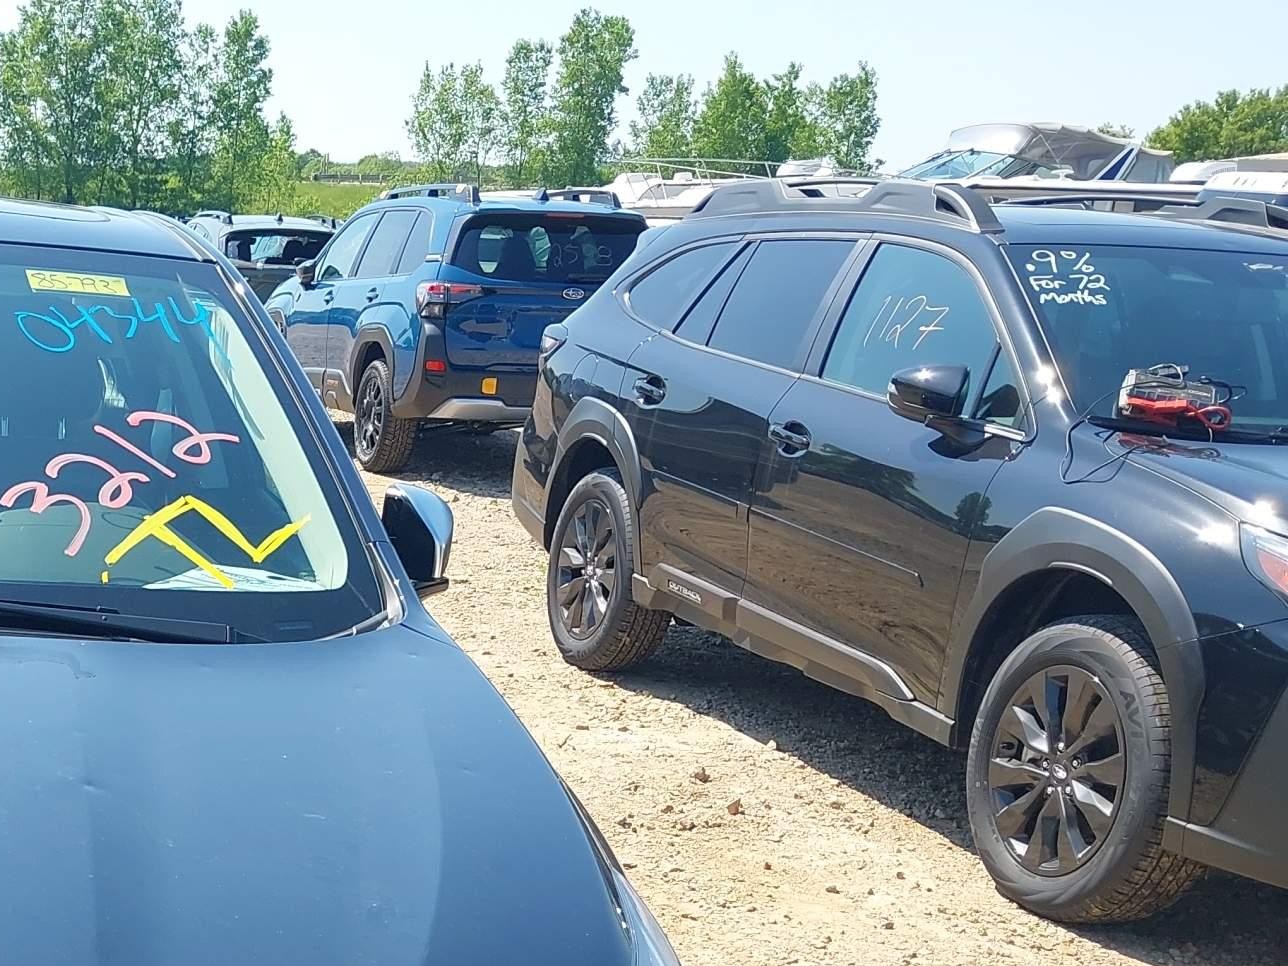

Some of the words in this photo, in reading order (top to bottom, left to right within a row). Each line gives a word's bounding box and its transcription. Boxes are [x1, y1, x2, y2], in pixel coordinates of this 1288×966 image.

[1024, 249, 1096, 273] .9%
[1068, 274, 1111, 292] 72
[862, 295, 950, 350] 1127
[0, 410, 241, 557] 3212
[668, 580, 702, 604] OUTBACK
